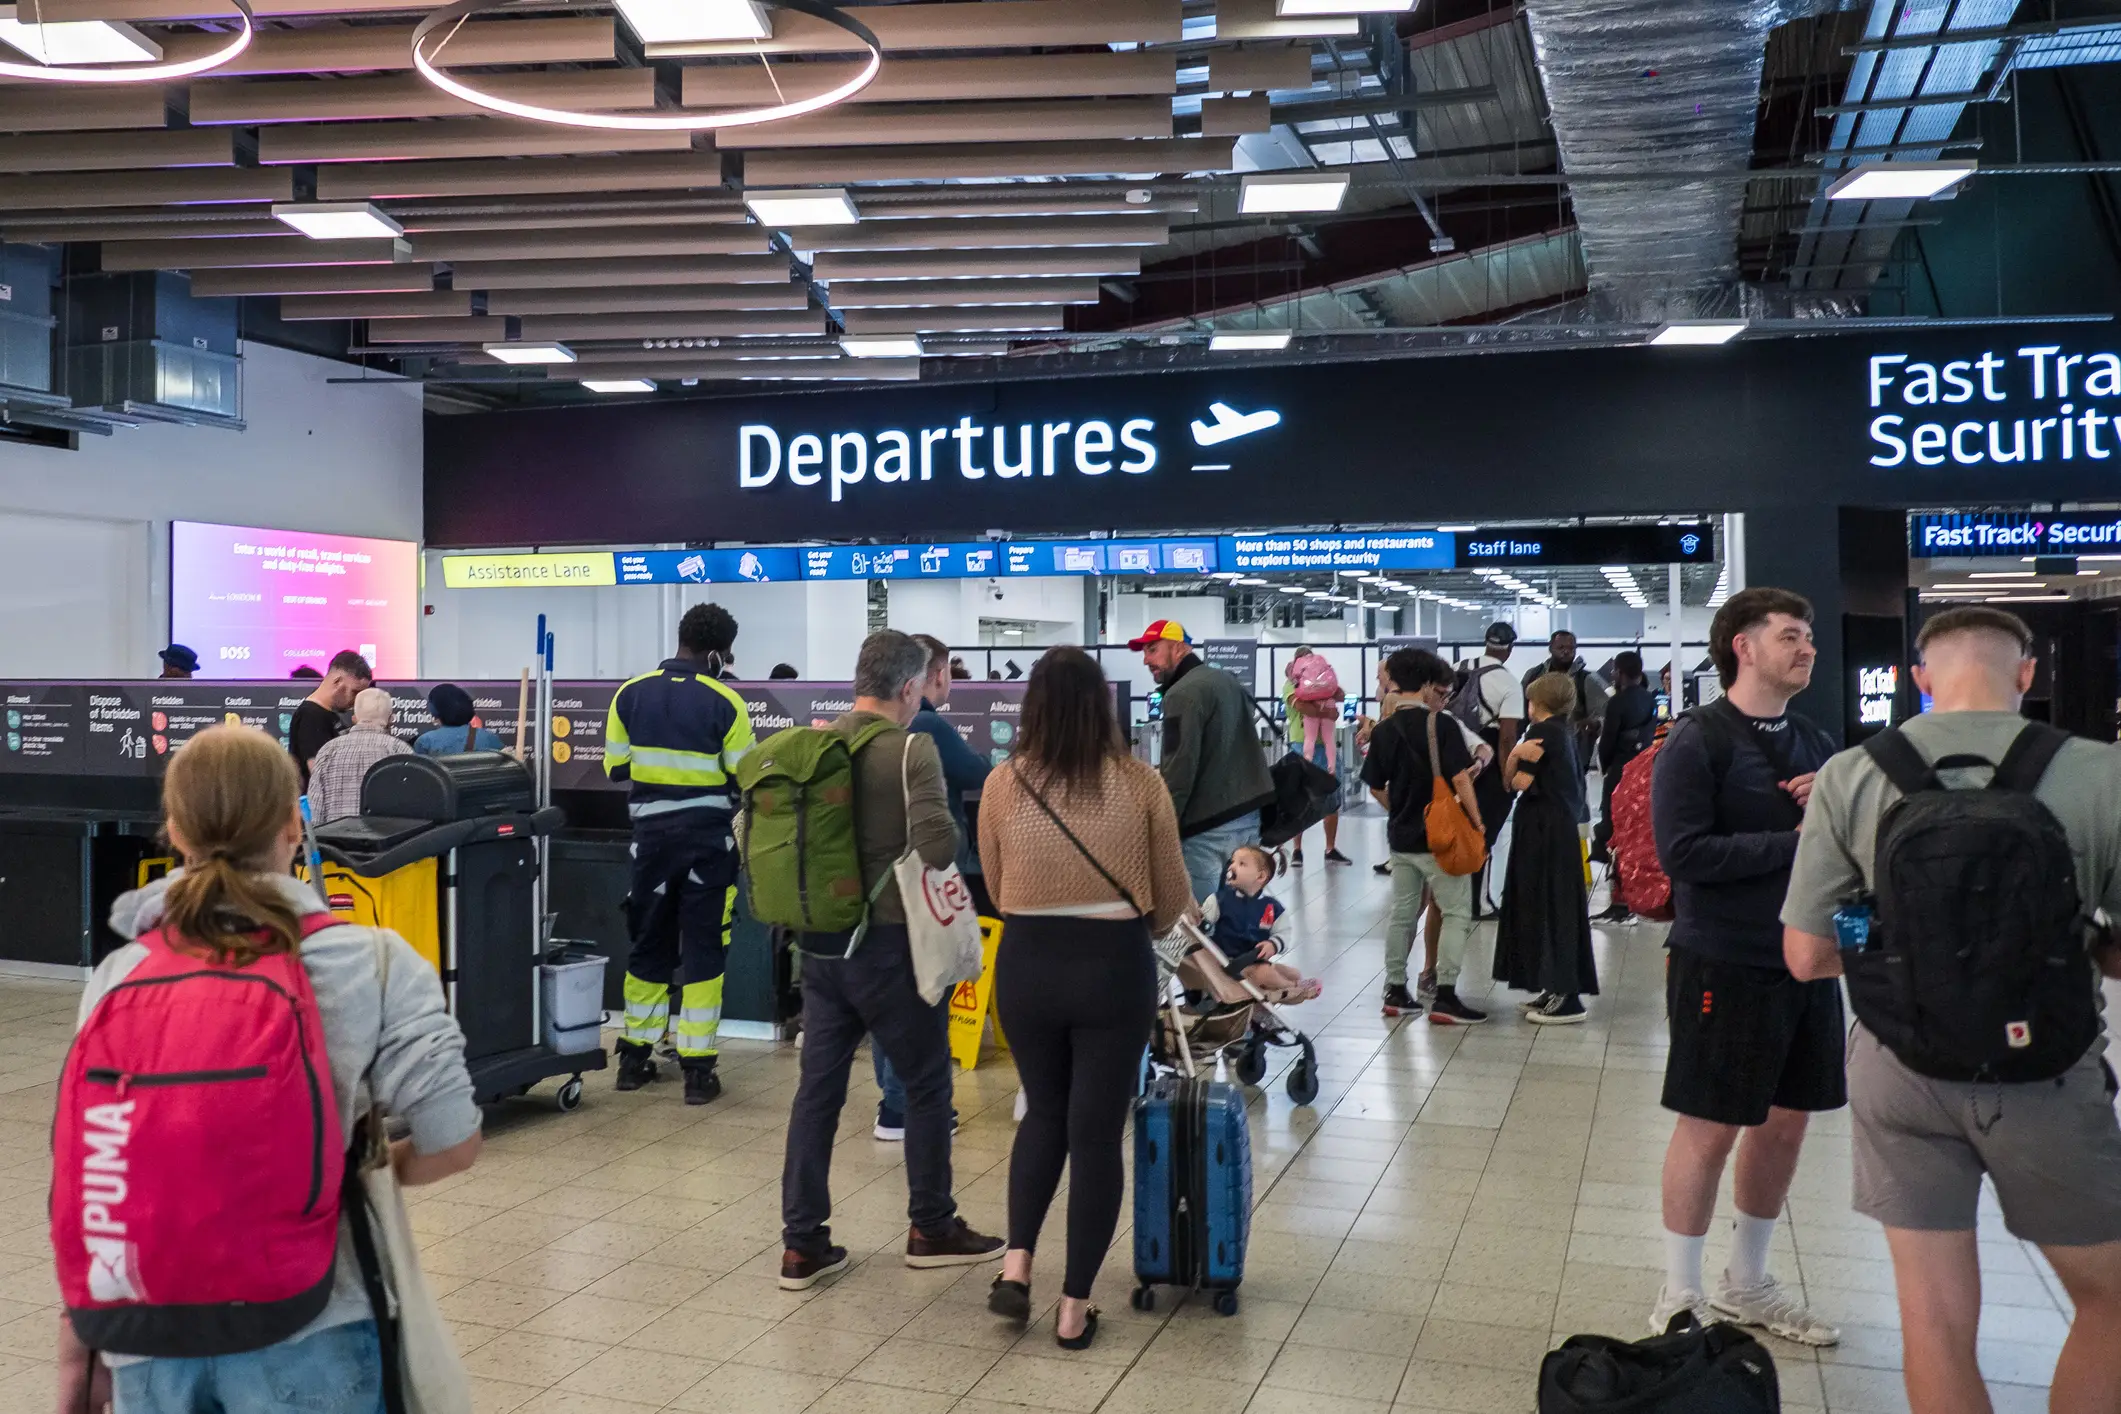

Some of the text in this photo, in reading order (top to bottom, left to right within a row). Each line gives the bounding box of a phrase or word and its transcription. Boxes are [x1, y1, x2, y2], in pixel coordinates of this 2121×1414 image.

[1870, 352, 2007, 407] Fast
[1869, 403, 2121, 467] Securit
[740, 417, 1156, 501] Departures
[1925, 525, 1973, 546] Fast
[1974, 522, 2037, 545] Track
[1236, 536, 1434, 552] More than 50 shops and restaurants
[1468, 541, 1541, 556] Staff lane
[1236, 551, 1380, 568] to explore beyond Security
[468, 563, 590, 580] Assistance Lane
[220, 646, 251, 659] BOSS
[89, 695, 122, 707] Dispose
[152, 696, 184, 705] Forbidden
[225, 697, 252, 706] Caution
[551, 699, 582, 709] Caution
[990, 701, 1022, 712] Allowe
[89, 708, 140, 719] of forbidden
[89, 721, 114, 732] items
[750, 715, 794, 728] rbidden
[81, 1100, 136, 1235] PUMA
